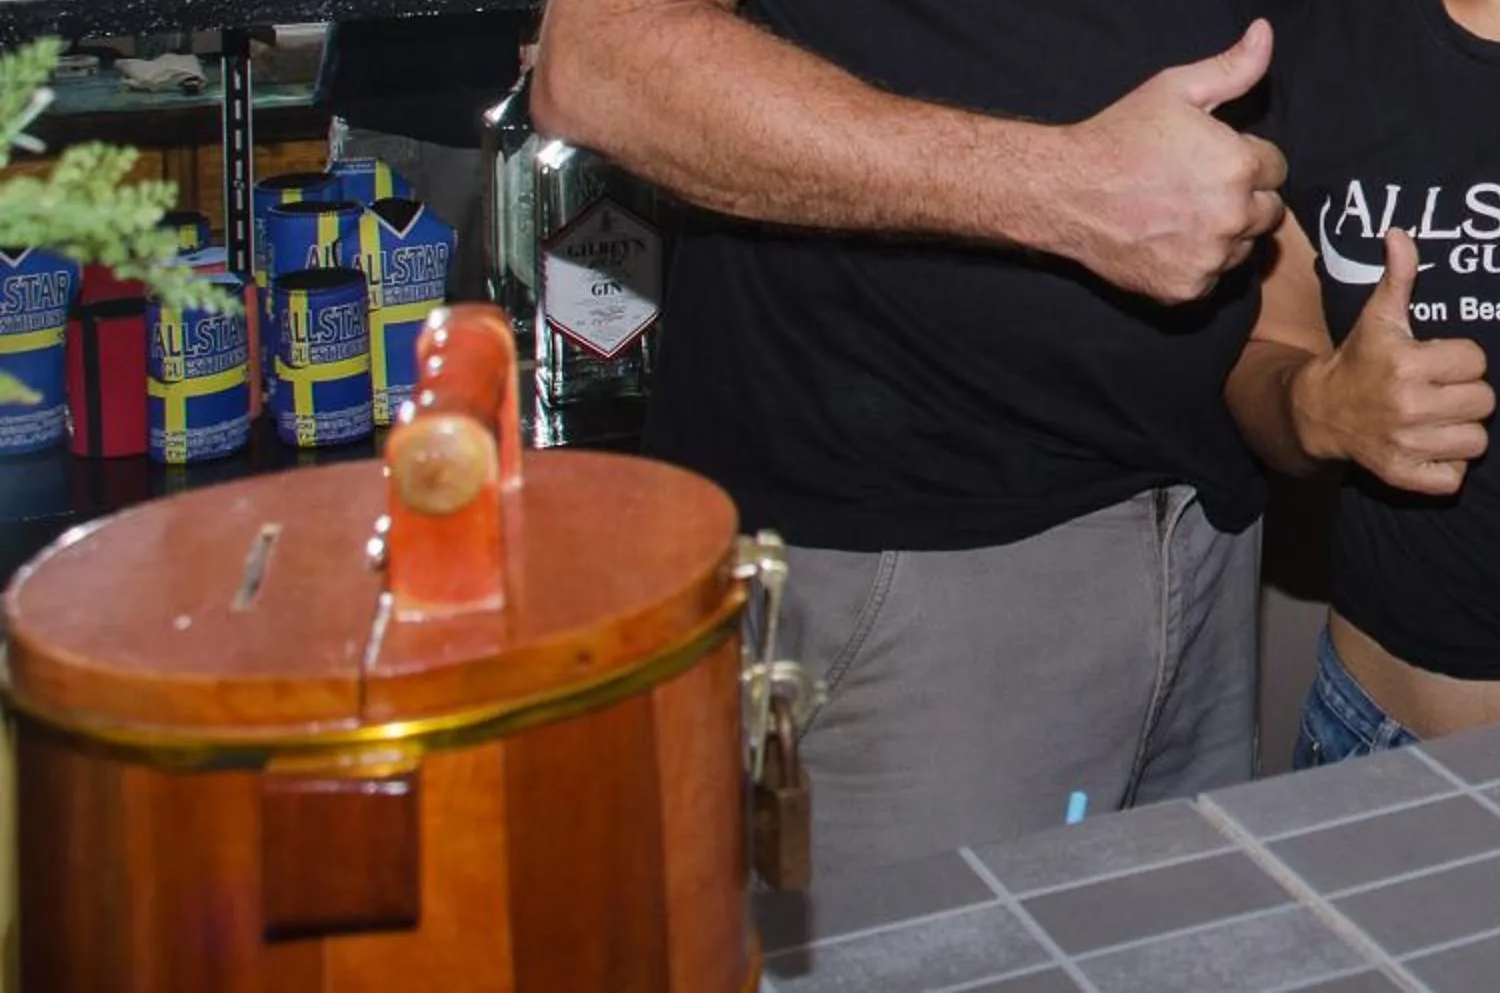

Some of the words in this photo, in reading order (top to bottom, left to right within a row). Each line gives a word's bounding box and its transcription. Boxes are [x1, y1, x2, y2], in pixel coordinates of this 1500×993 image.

[352, 242, 449, 286] ALLSTAR
[591, 281, 623, 297] GIN
[150, 313, 247, 358] ALLSTA
[281, 301, 367, 345] ALLSTA
